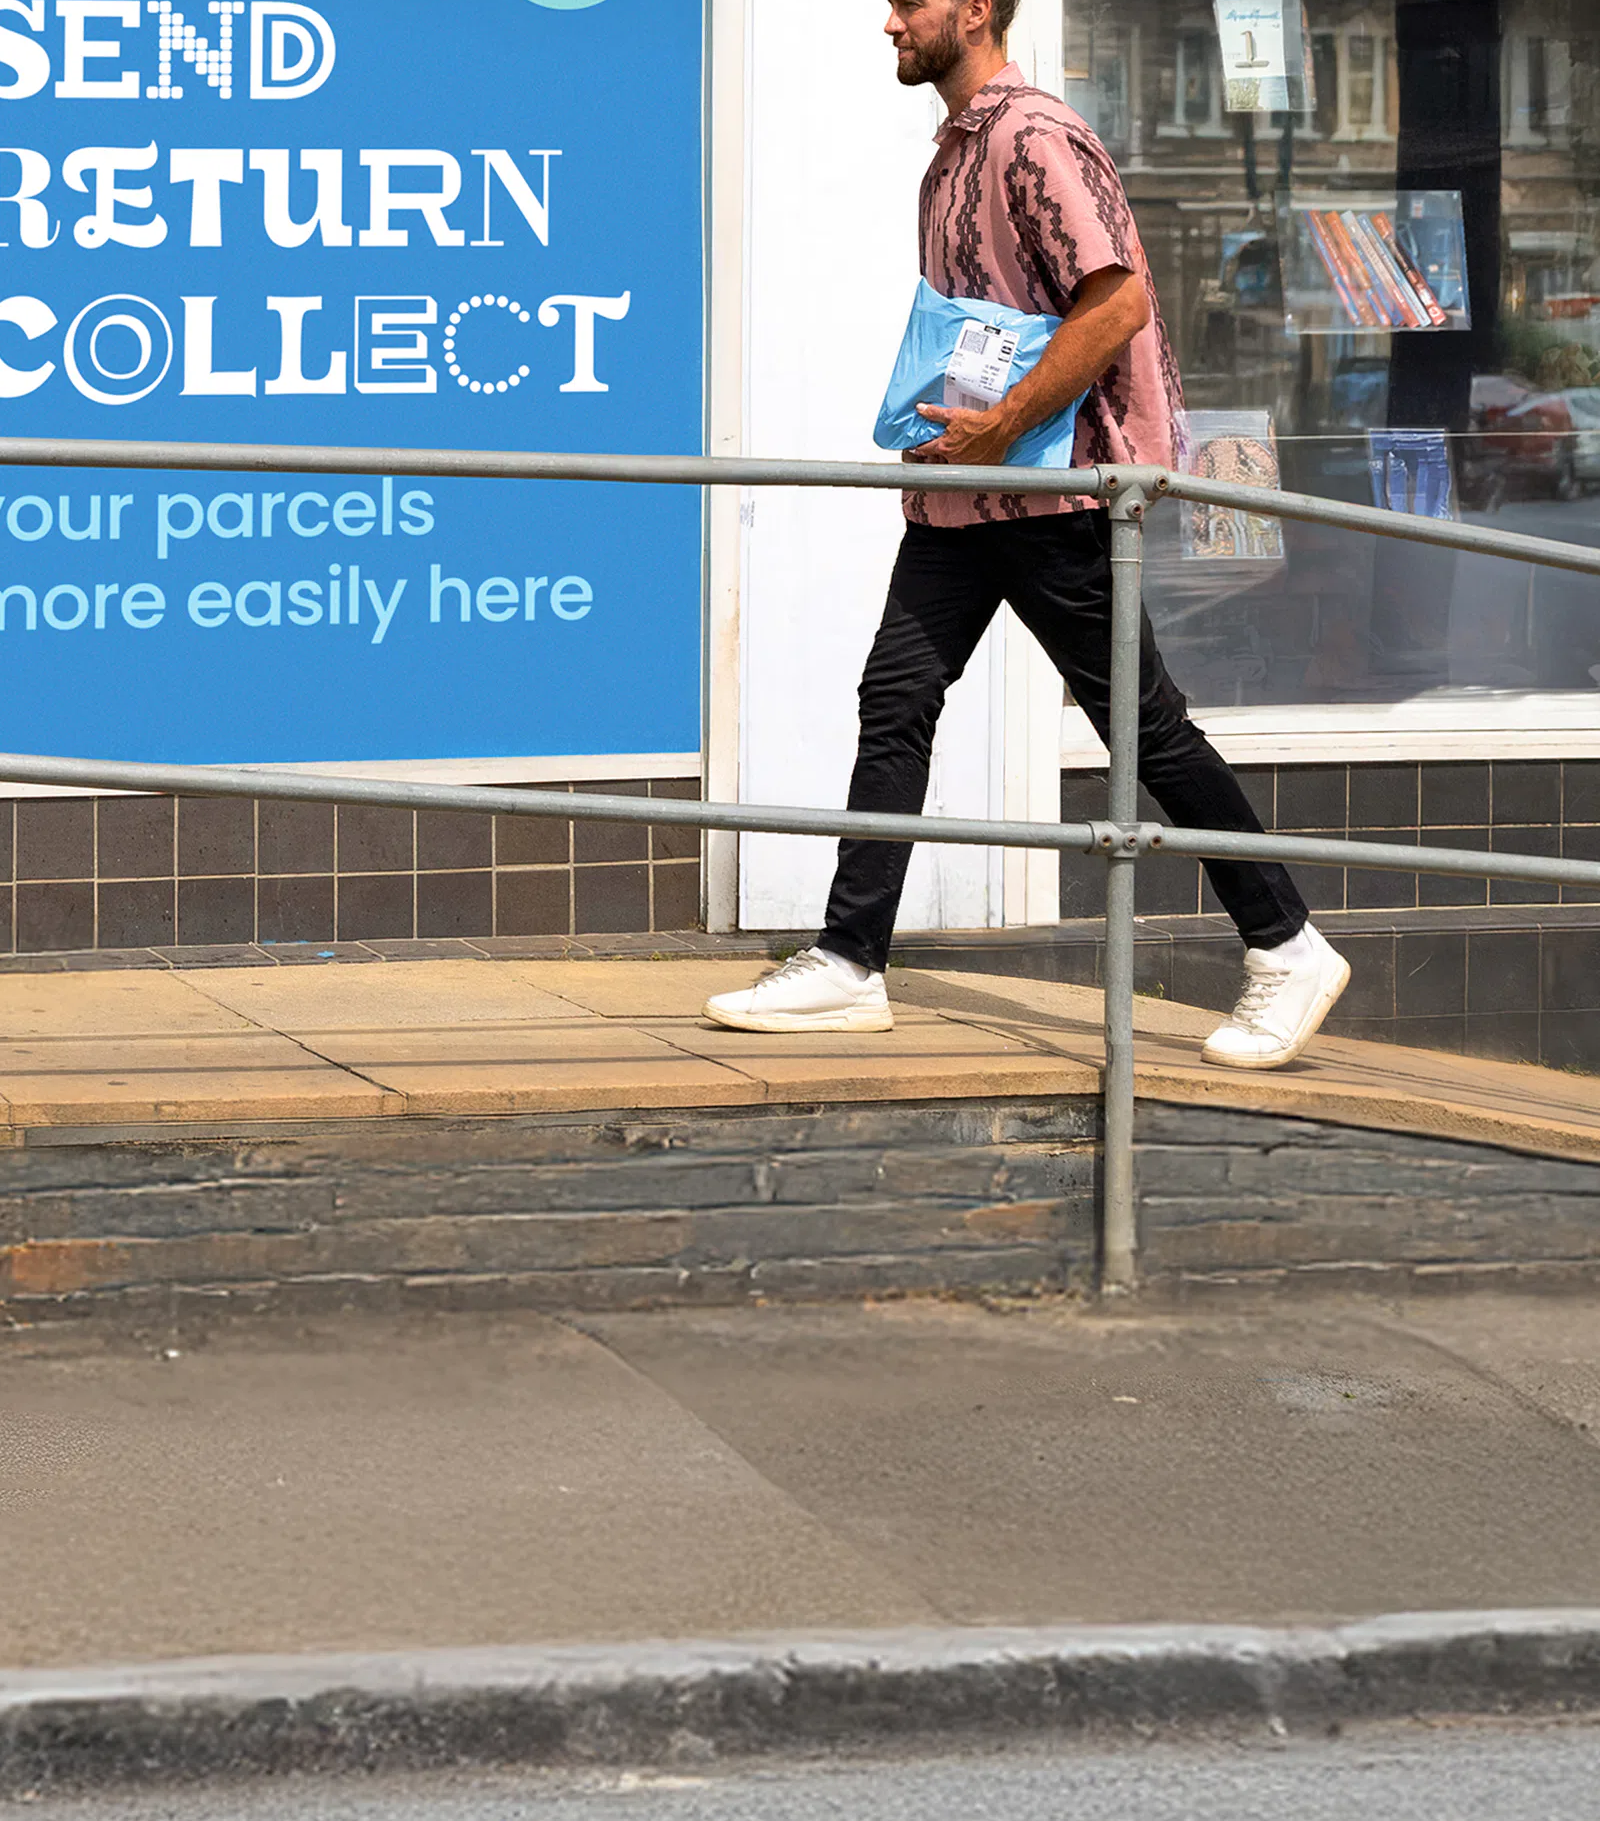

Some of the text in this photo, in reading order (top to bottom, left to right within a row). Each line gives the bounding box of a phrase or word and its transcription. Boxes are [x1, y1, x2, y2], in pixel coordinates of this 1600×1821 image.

[157, 476, 435, 560] parcels
[187, 562, 408, 645] easily
[429, 563, 595, 623] here
